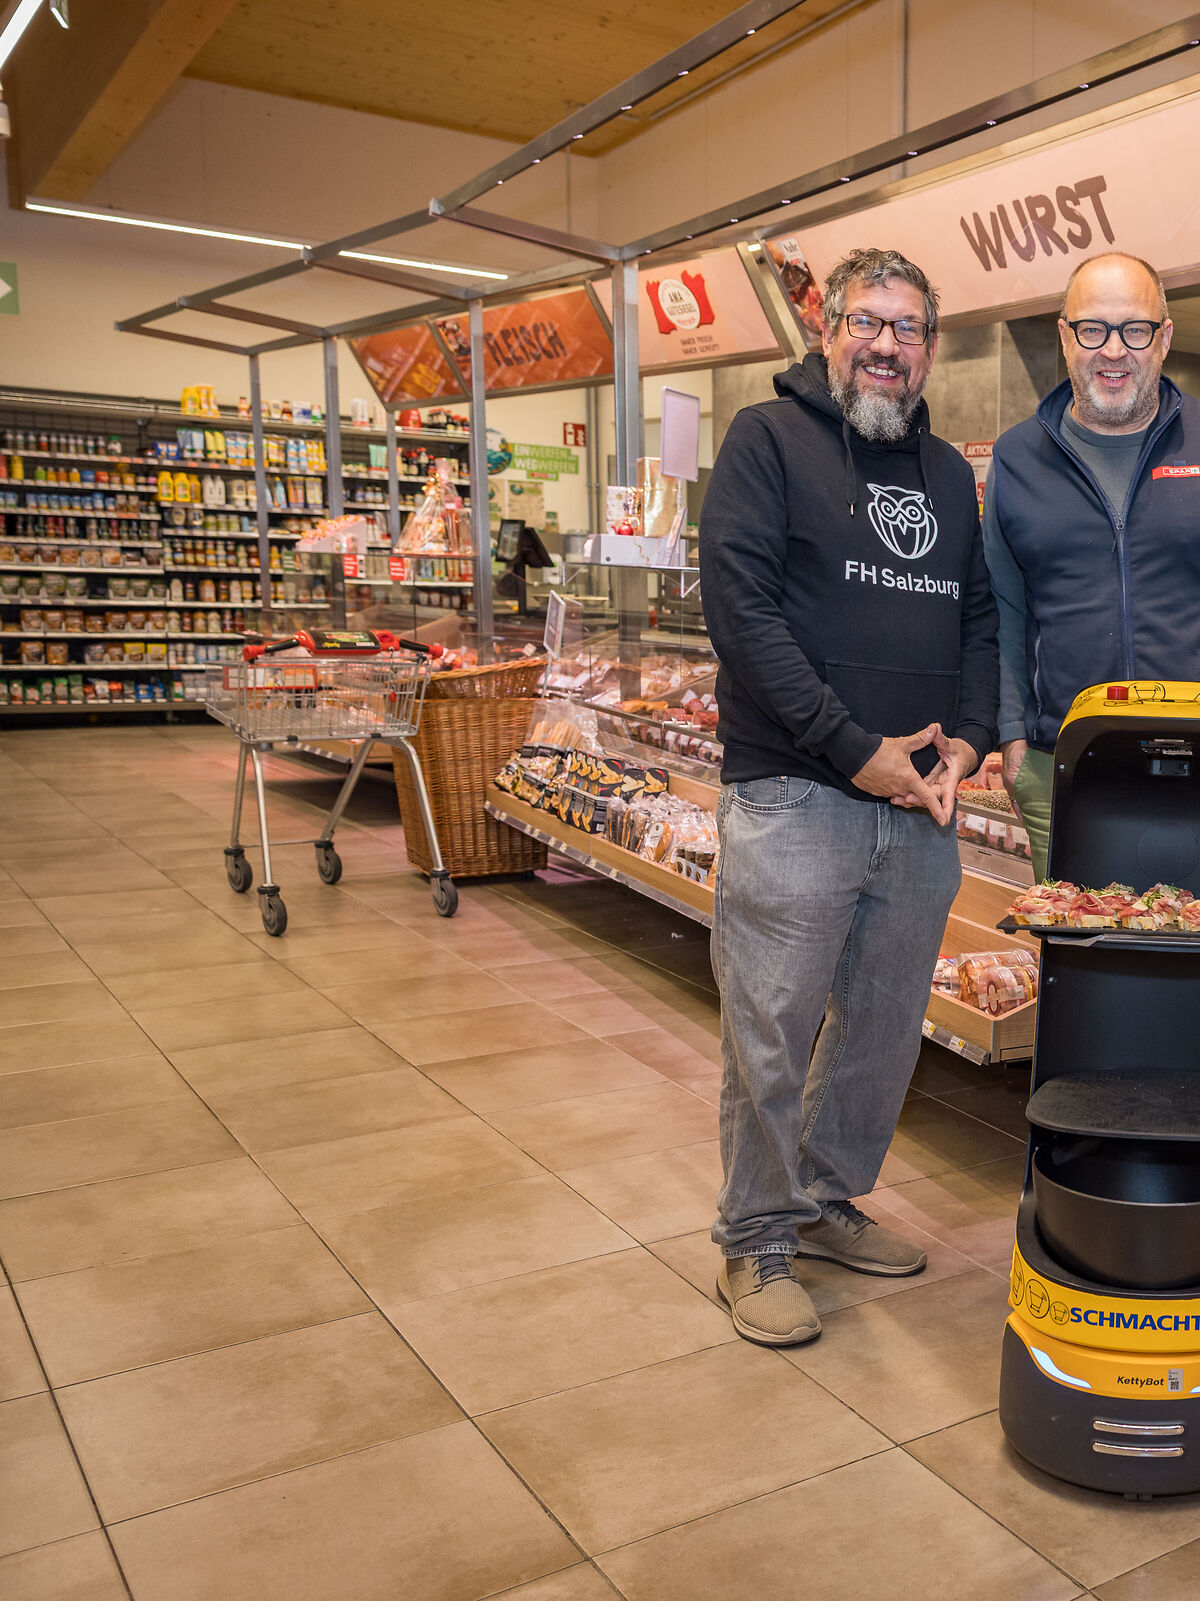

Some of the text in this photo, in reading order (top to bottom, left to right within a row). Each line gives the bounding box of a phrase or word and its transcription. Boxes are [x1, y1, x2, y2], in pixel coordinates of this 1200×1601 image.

[960, 175, 1115, 272] WURST
[966, 444, 993, 456] AKTION
[845, 560, 960, 600] FH Salzburg
[1117, 1375, 1164, 1388] KettyBot
